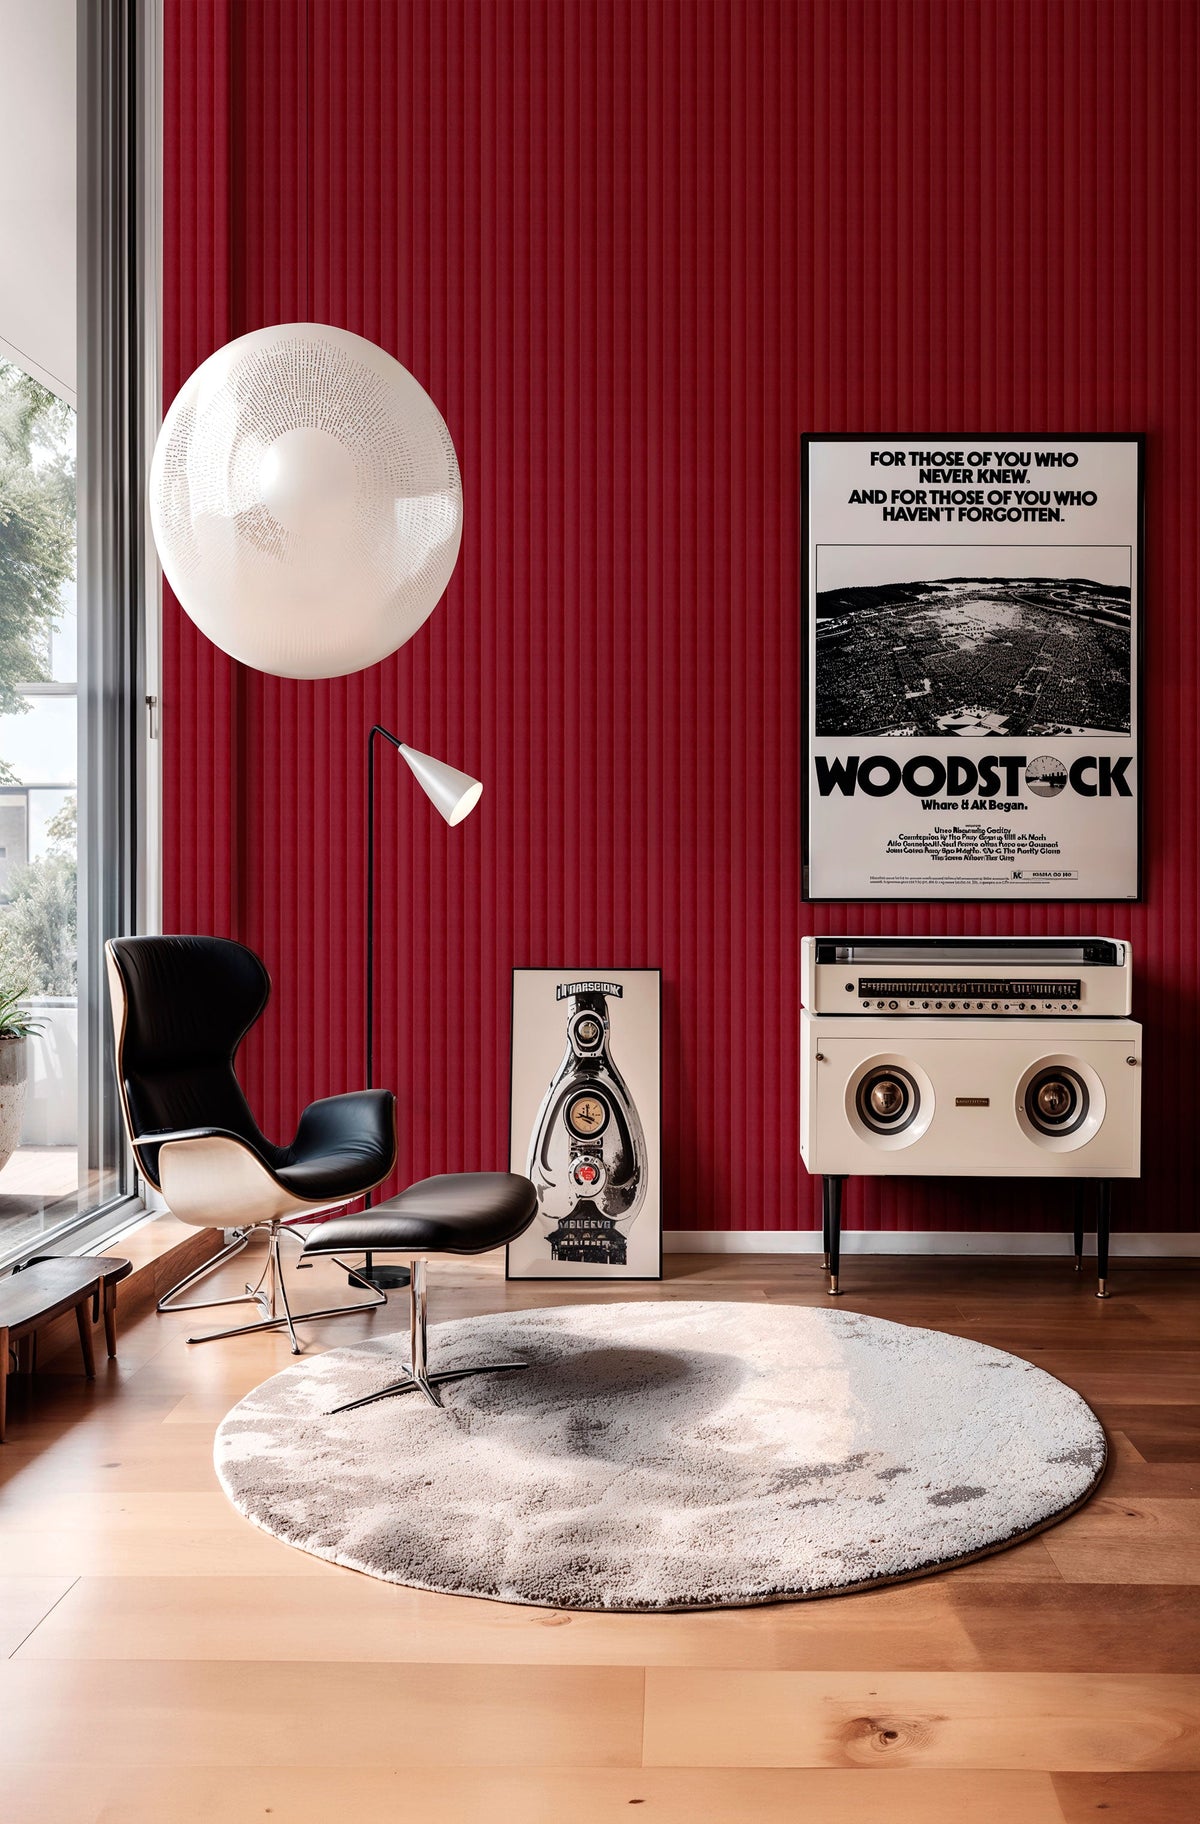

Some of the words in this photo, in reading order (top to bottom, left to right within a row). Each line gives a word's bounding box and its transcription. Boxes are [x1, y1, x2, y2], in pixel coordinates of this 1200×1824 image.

[870, 451, 906, 466] FOR
[909, 451, 965, 466] THOSE
[967, 451, 990, 466] OF
[994, 452, 1031, 467] YOU
[1035, 452, 1079, 467] WHO
[919, 469, 973, 484] NEVER
[977, 469, 1031, 484] KNEW.
[848, 489, 887, 504] AND
[891, 490, 927, 504] FOR
[929, 490, 984, 505] THOSE
[987, 490, 1011, 505] OF
[1014, 490, 1050, 505] YOU
[1054, 490, 1097, 506] WHO
[883, 507, 956, 522] HAVEN'T
[958, 507, 1065, 522] FORGOTTEN.
[989, 799, 1028, 812] Began.
